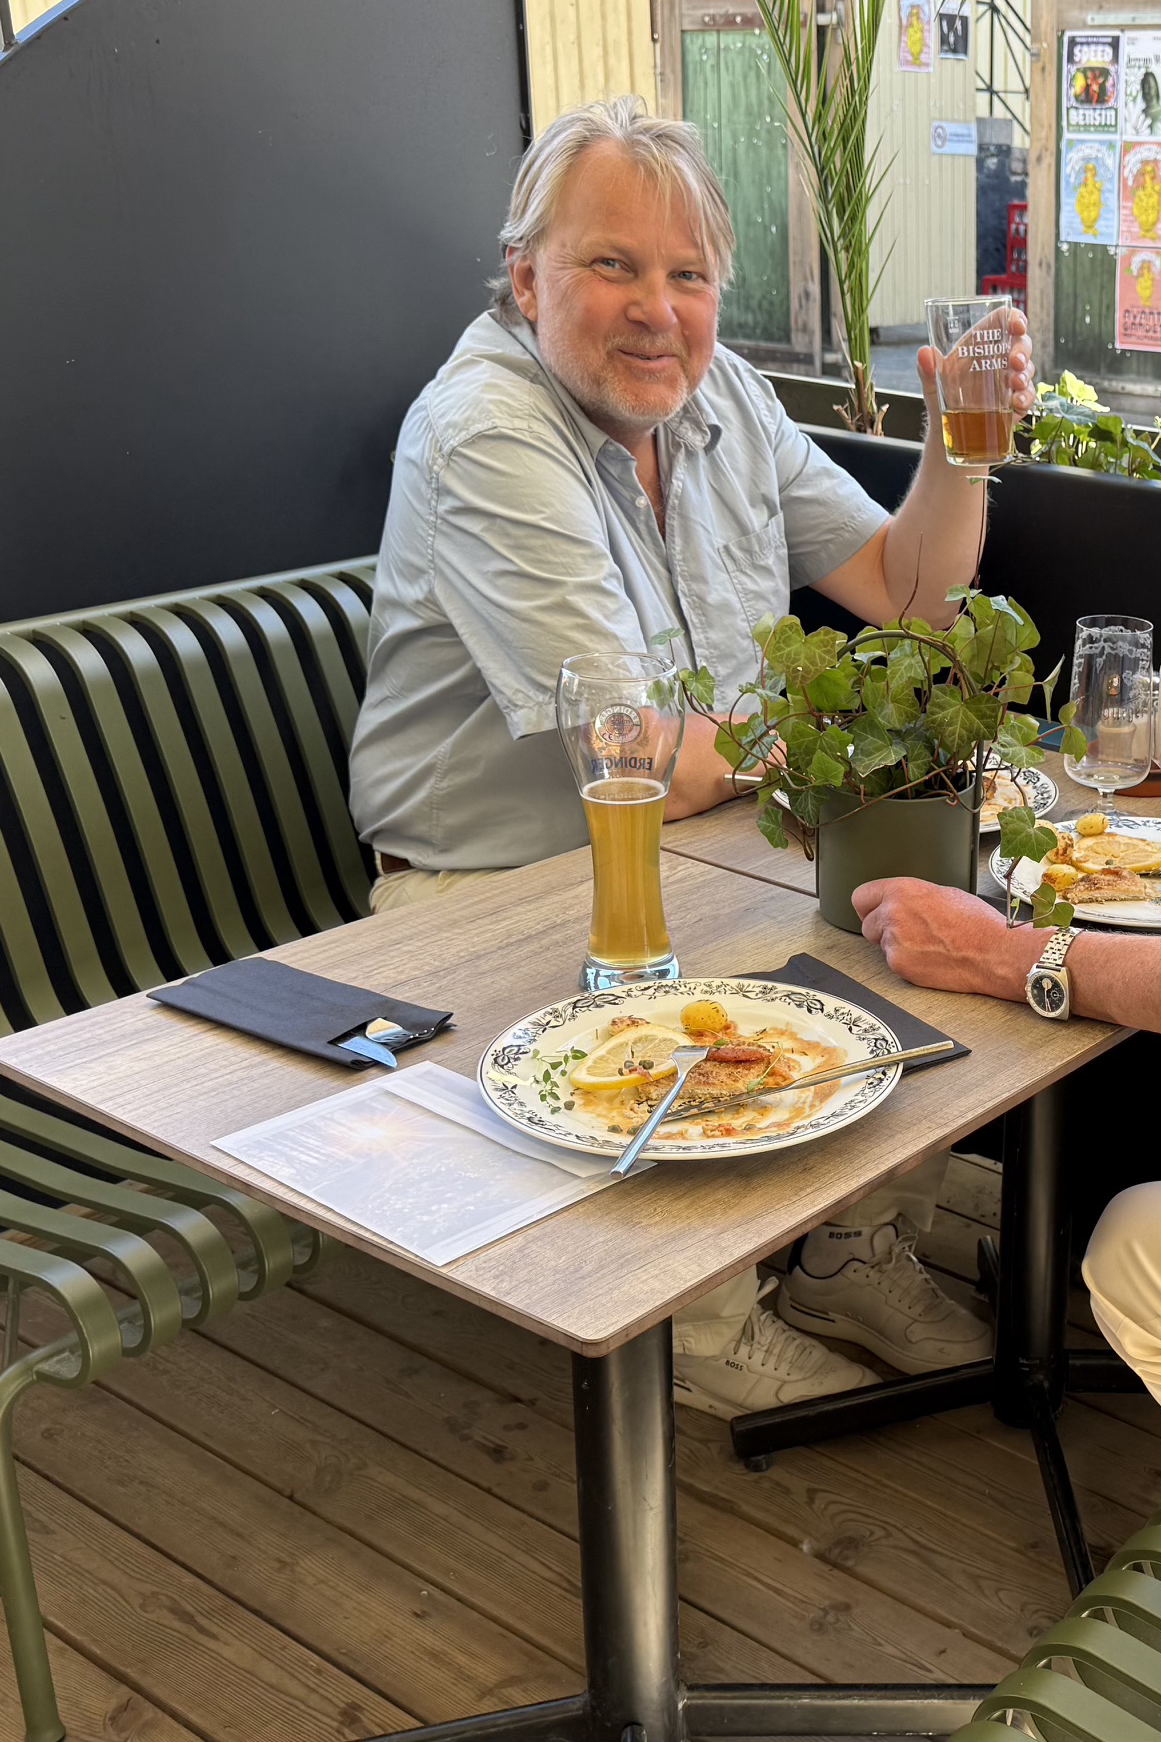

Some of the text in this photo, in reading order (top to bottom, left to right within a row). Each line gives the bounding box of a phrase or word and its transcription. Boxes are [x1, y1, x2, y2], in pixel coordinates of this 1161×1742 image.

[973, 328, 1001, 342] THE
[969, 356, 1008, 372] ARMS
[724, 1359, 744, 1372] BOSS
